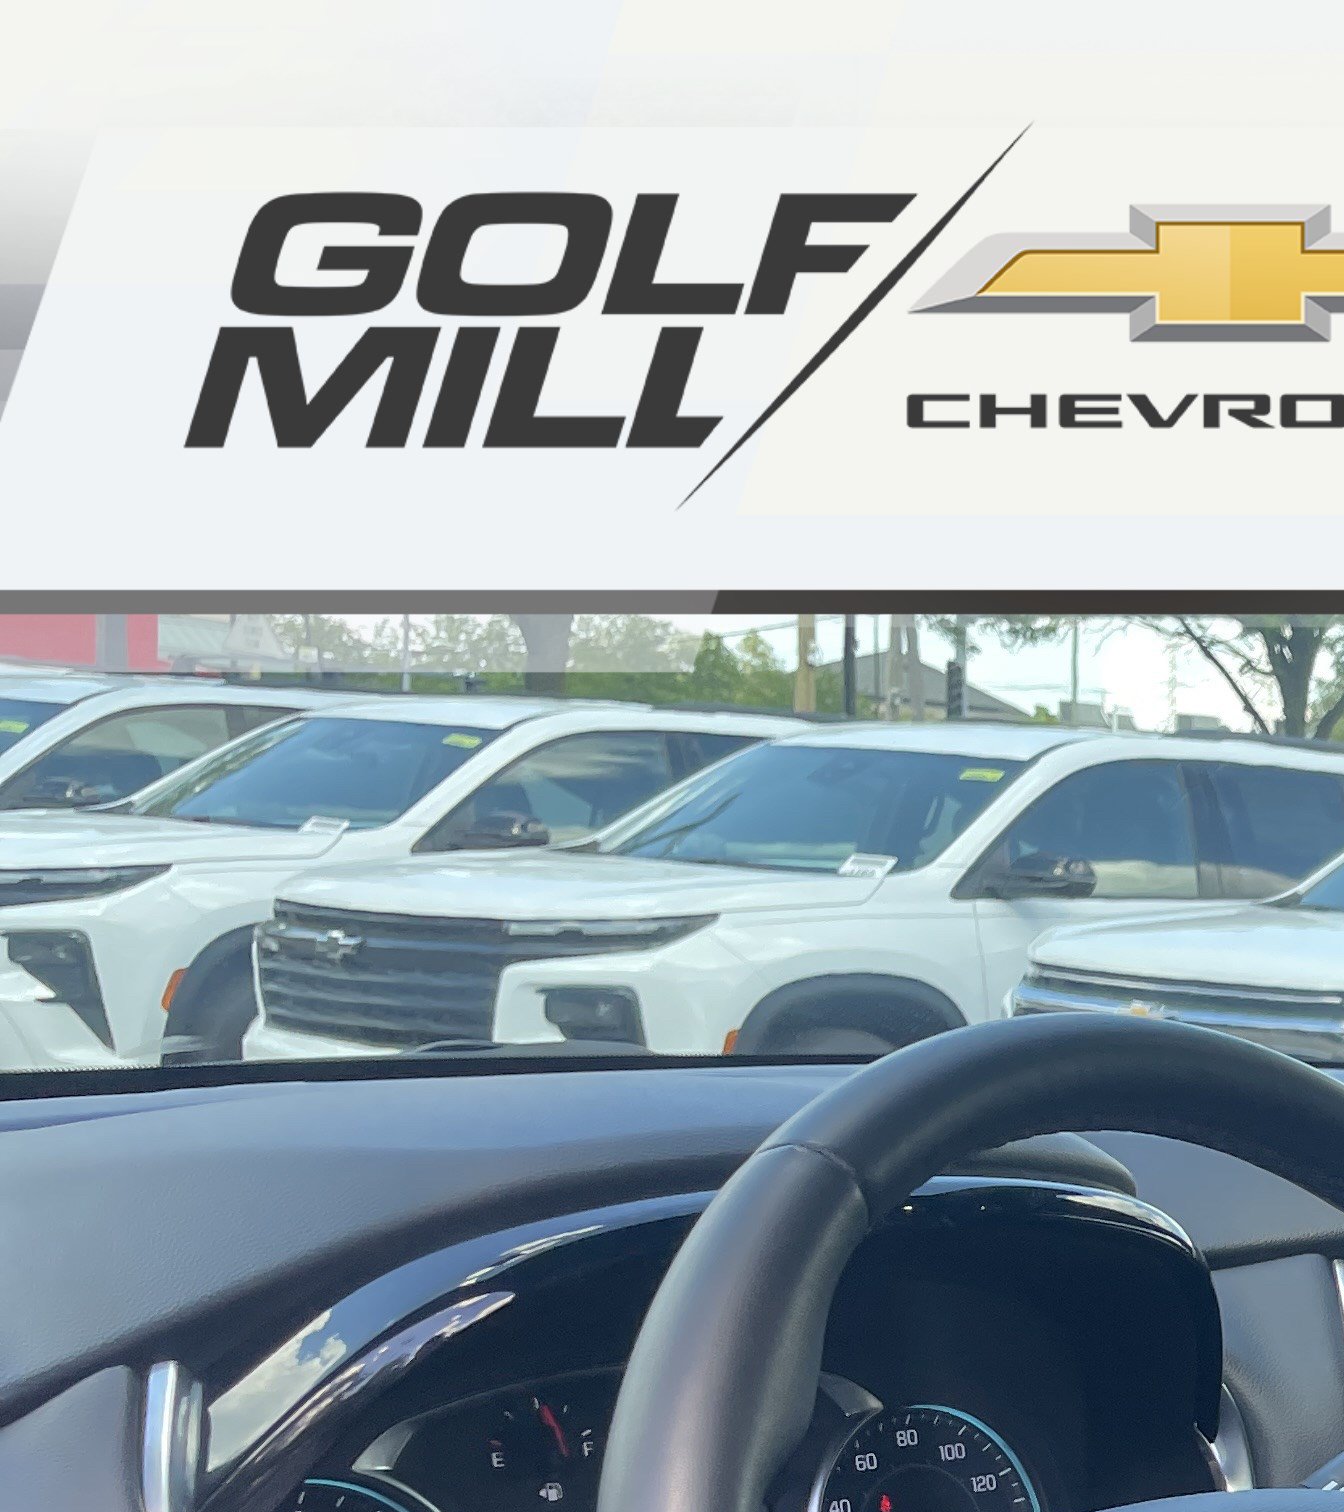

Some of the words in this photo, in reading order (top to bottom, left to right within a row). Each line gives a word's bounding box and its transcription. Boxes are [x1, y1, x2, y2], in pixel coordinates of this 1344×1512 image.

[895, 1428, 918, 1448] 80
[854, 1452, 878, 1472] 60
[938, 1442, 966, 1462] 100
[970, 1473, 997, 1493] 120
